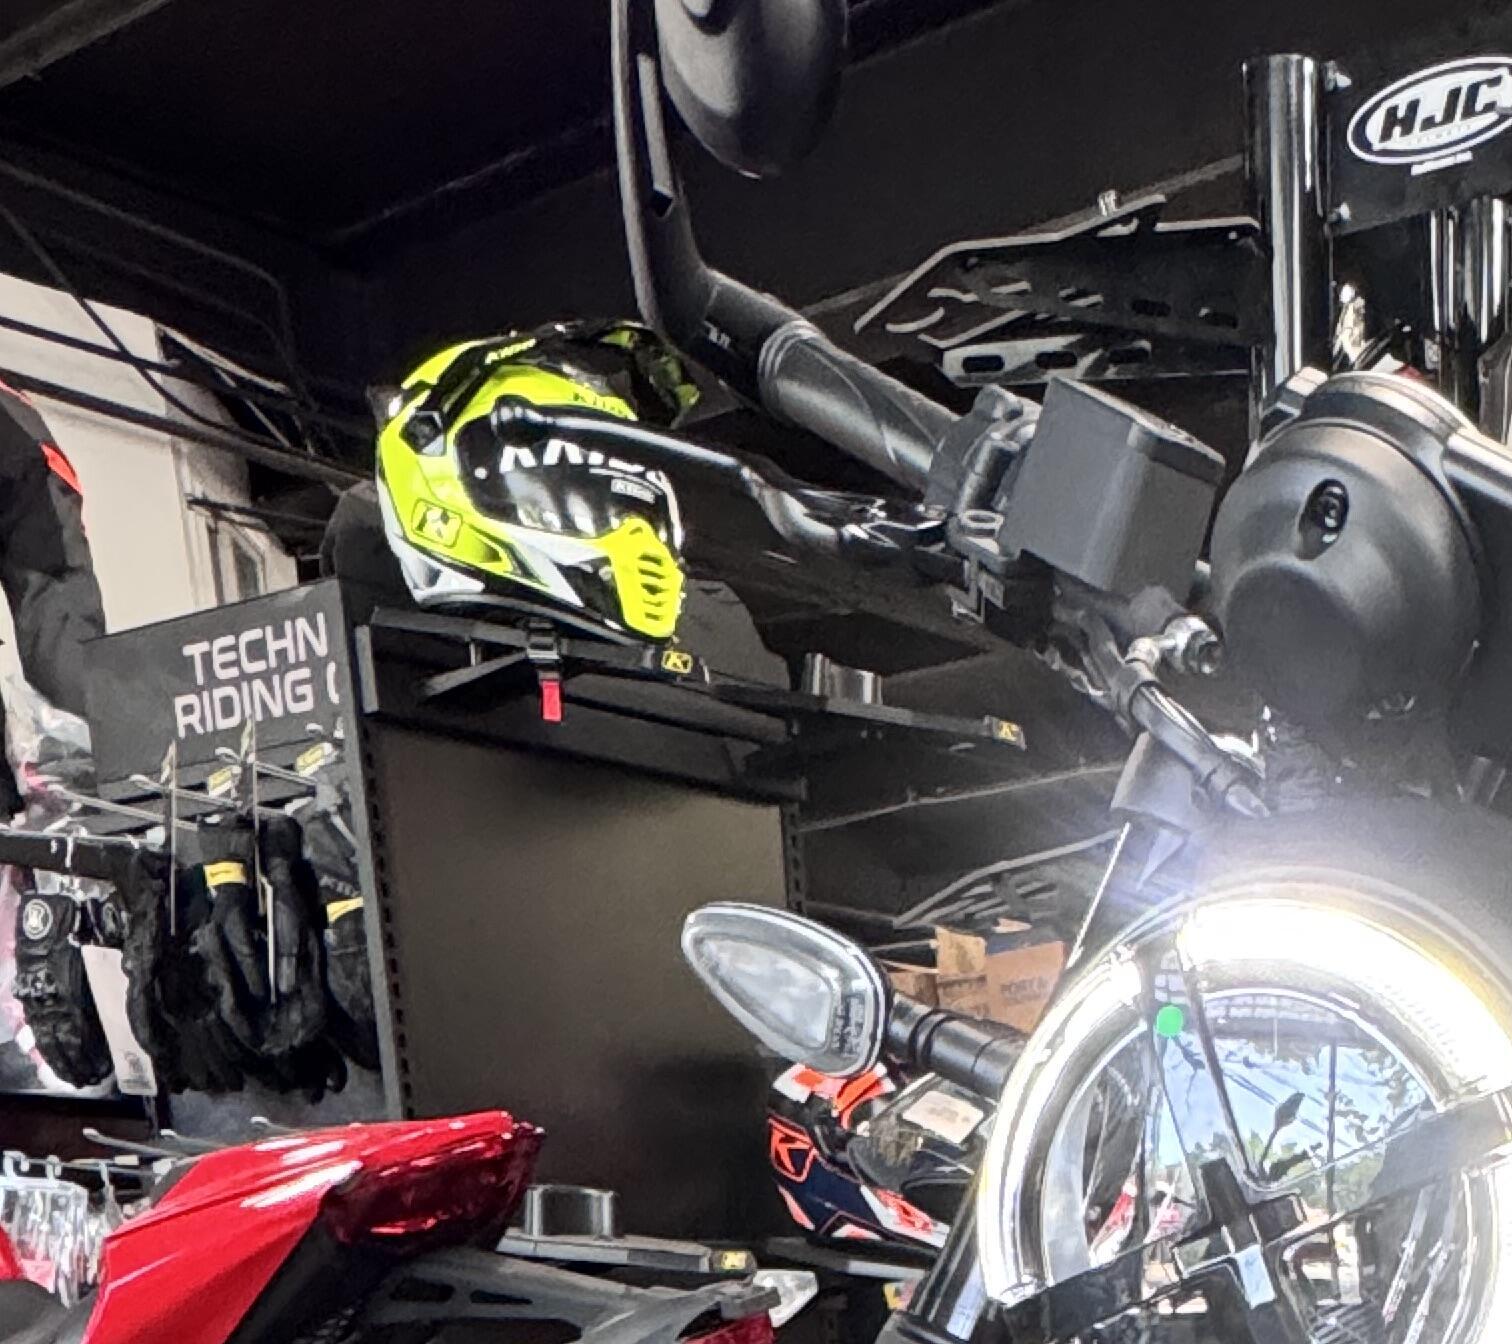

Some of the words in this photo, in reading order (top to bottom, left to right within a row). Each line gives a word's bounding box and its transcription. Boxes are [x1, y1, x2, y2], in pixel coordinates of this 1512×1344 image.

[1378, 75, 1503, 143] HJC
[182, 612, 328, 686] TECHN
[174, 667, 314, 739] RIDING
